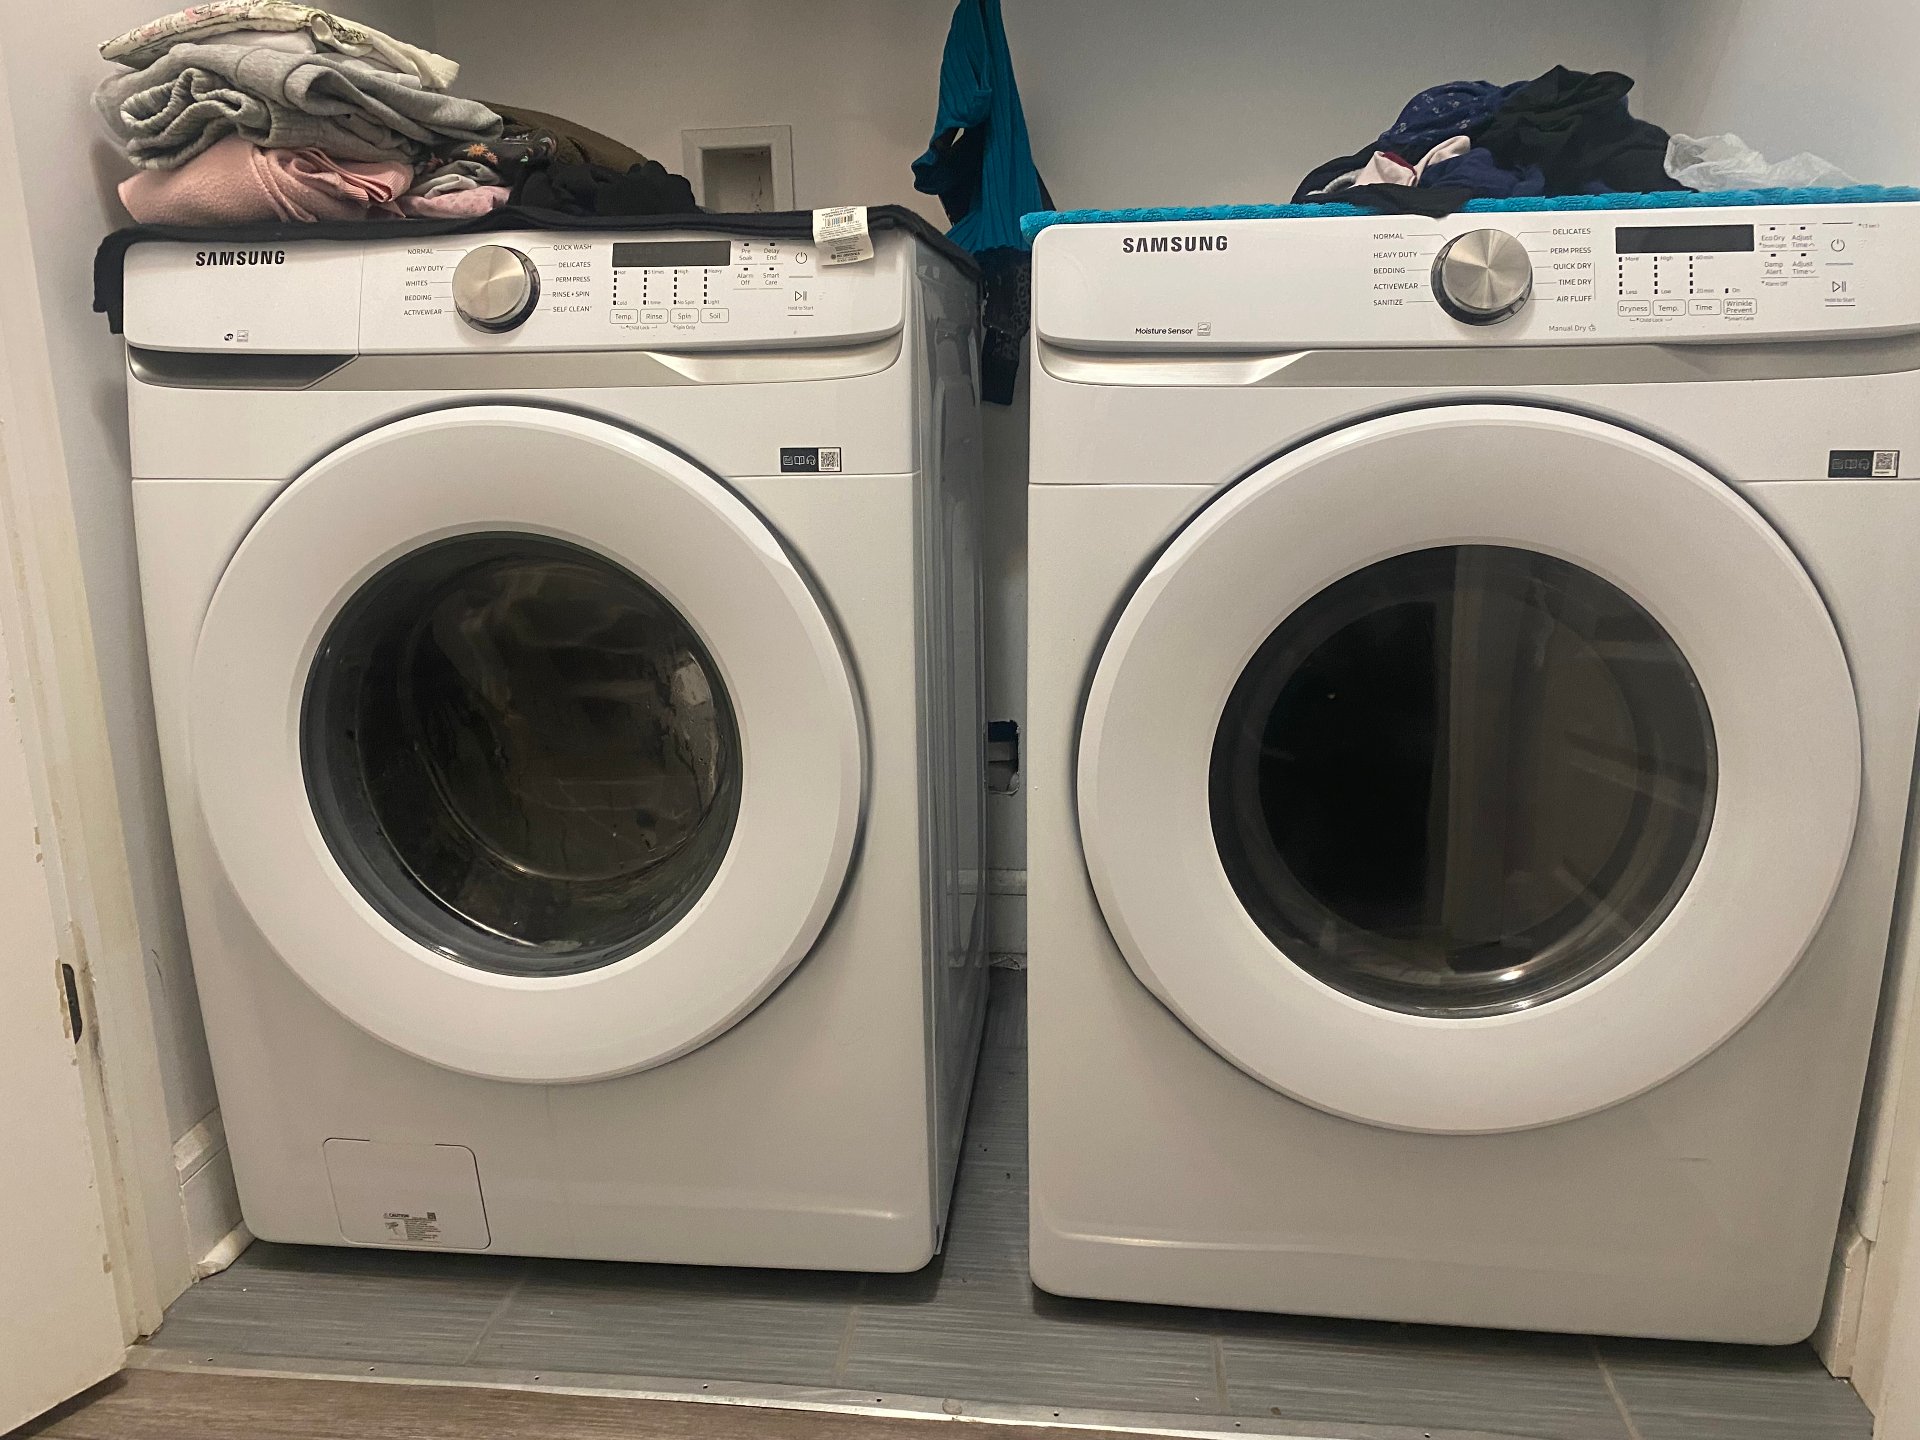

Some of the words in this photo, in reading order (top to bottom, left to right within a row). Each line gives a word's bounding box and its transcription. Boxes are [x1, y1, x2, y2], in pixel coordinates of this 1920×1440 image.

[1122, 236, 1228, 253] SAMSUNG
[196, 250, 285, 266] SAMSUNG
[1620, 305, 1648, 313] Dryness
[645, 312, 663, 320] Rinse
[677, 312, 692, 321] Spin
[709, 311, 721, 319] Soil
